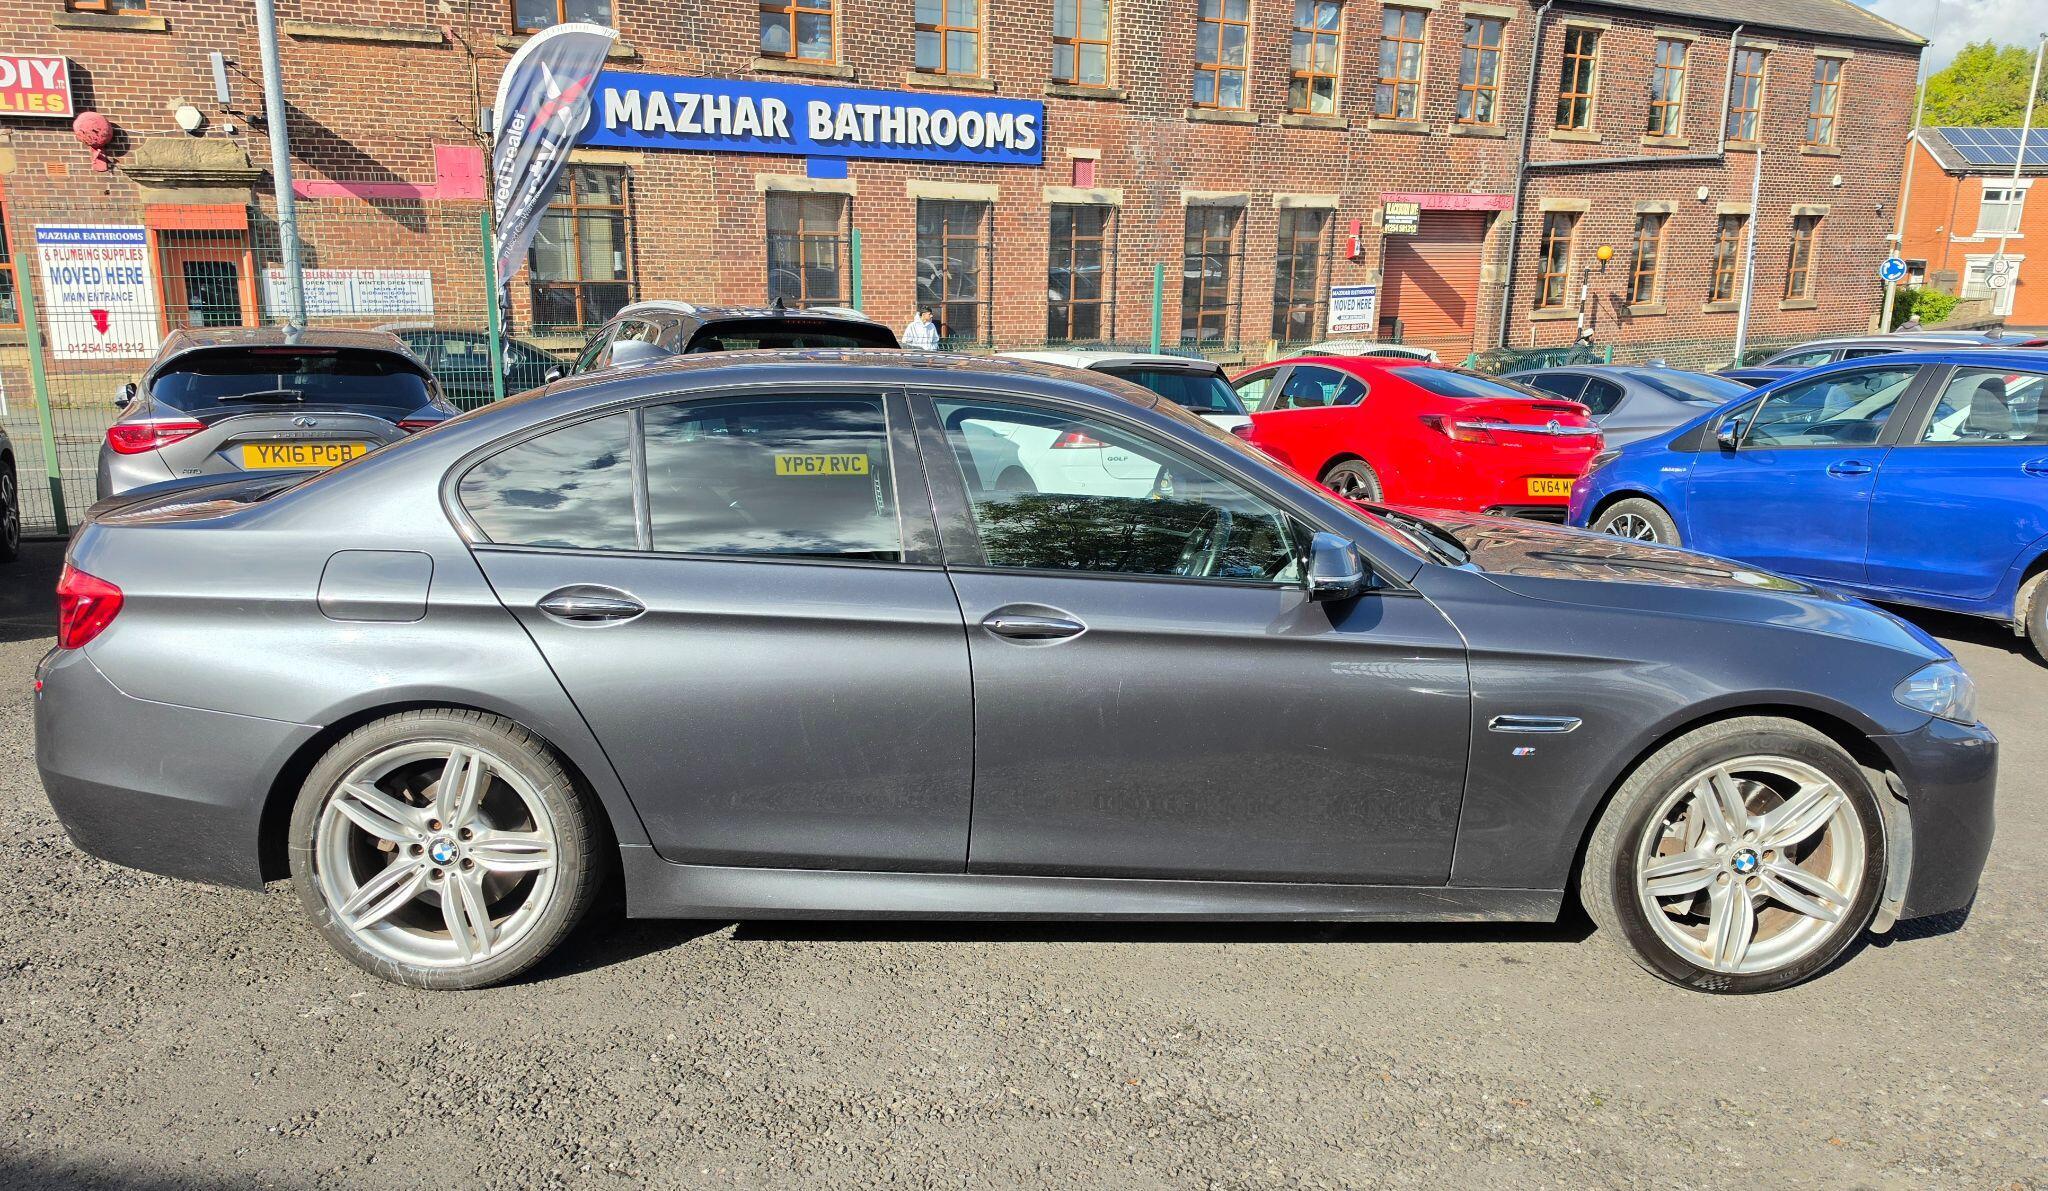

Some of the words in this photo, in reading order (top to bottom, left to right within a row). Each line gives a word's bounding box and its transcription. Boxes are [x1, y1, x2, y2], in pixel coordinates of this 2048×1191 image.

[0, 58, 60, 89] DIY
[0, 92, 65, 112] LIES
[603, 87, 791, 139] MAZHAR
[807, 100, 1037, 150] BATHROOMS
[38, 231, 81, 241] MAZHAR
[82, 232, 144, 241] BATHROOMS
[44, 248, 51, 261] &
[53, 248, 100, 261] PLUMBING
[102, 248, 144, 261] SUPPLIES
[49, 266, 101, 285] MOVED
[105, 266, 144, 285] HERE
[63, 291, 86, 302] MAIN
[87, 291, 134, 302] ENTRANCE
[1334, 298, 1355, 311] MOVED
[1356, 298, 1372, 310] HERE
[68, 343, 102, 354] 01254
[105, 342, 145, 353] 581212
[256, 444, 305, 463] YK16
[782, 456, 825, 472] YP67
[830, 456, 862, 472] RVC
[1532, 480, 1561, 493] CV64
